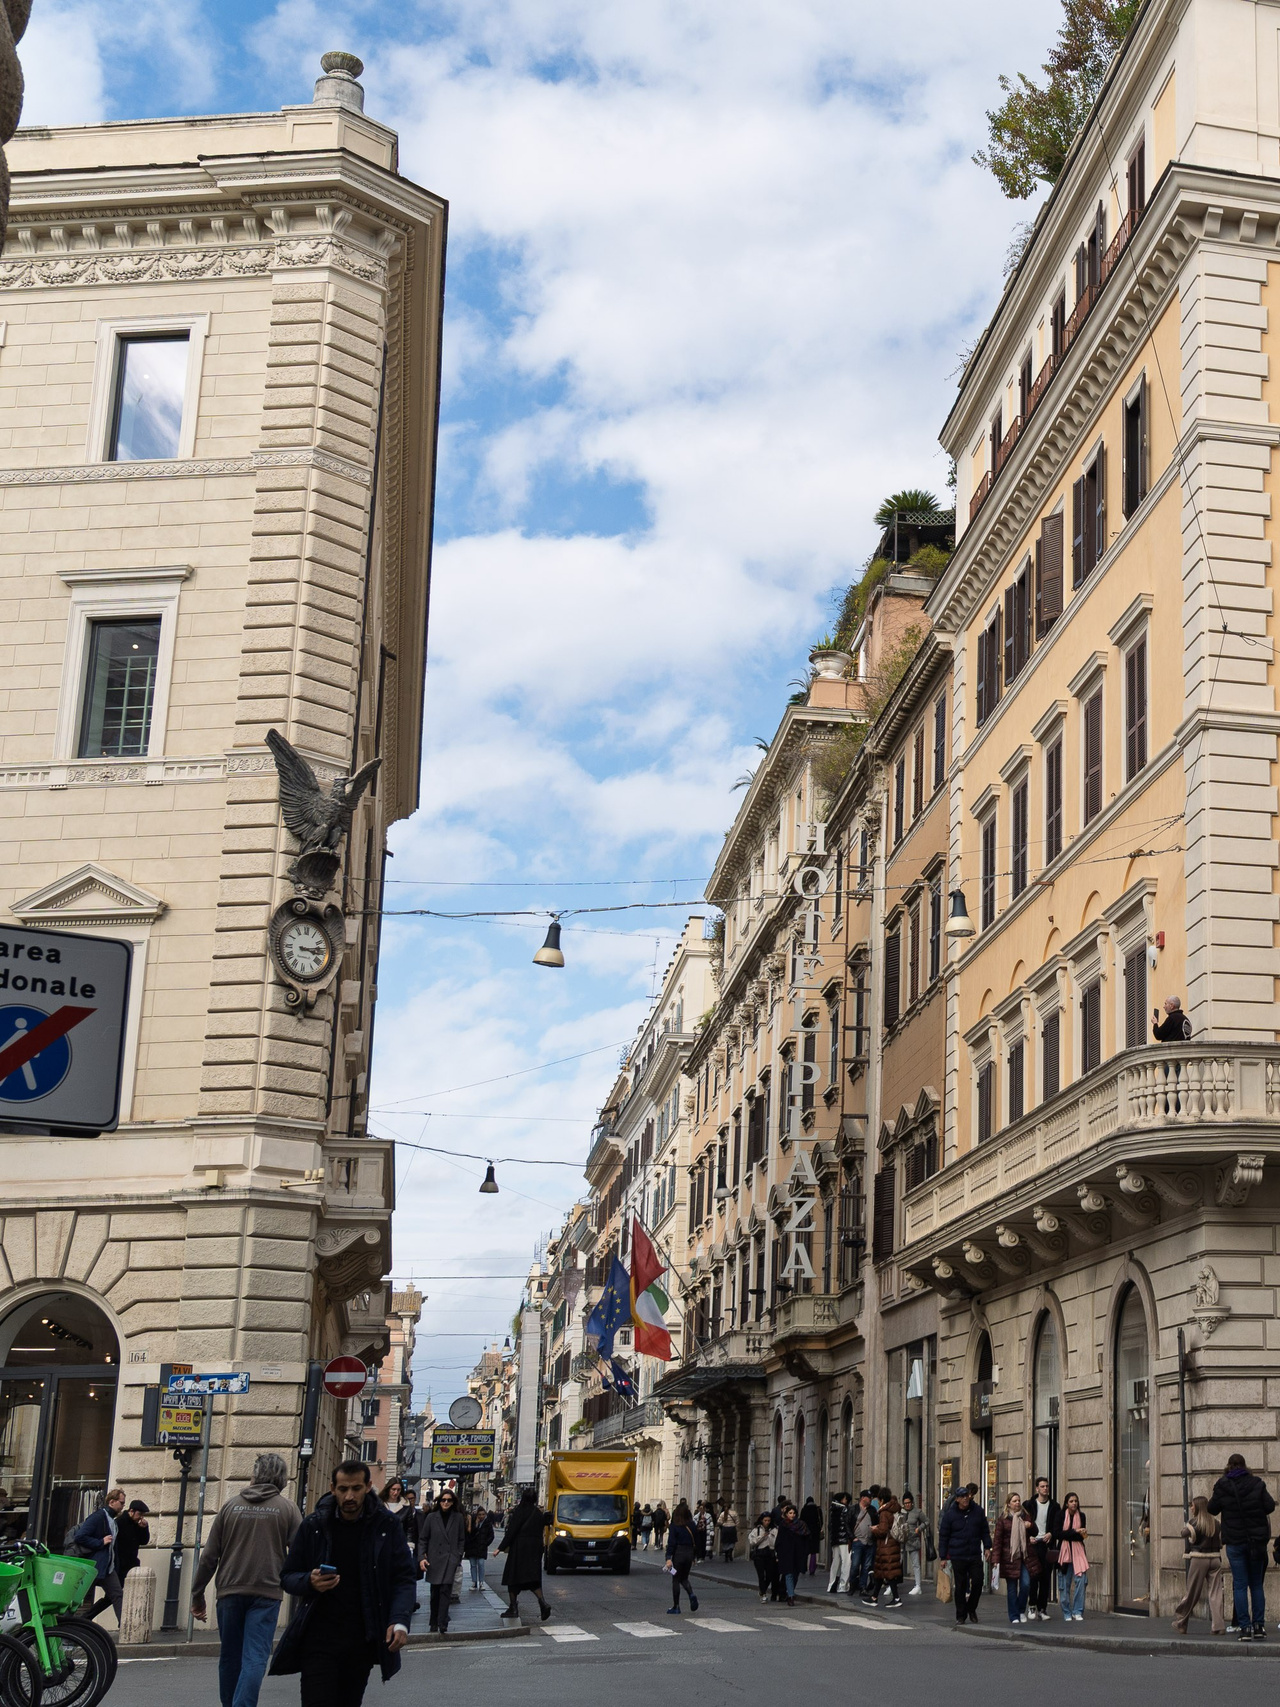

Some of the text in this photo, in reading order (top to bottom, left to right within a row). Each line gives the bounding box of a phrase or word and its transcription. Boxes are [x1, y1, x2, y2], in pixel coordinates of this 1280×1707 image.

[790, 822, 829, 1033] HOTEL
[0, 941, 61, 964] area
[780, 1061, 821, 1278] PLAZA
[130, 1352, 147, 1363] 164
[458, 1433, 469, 1446] &
